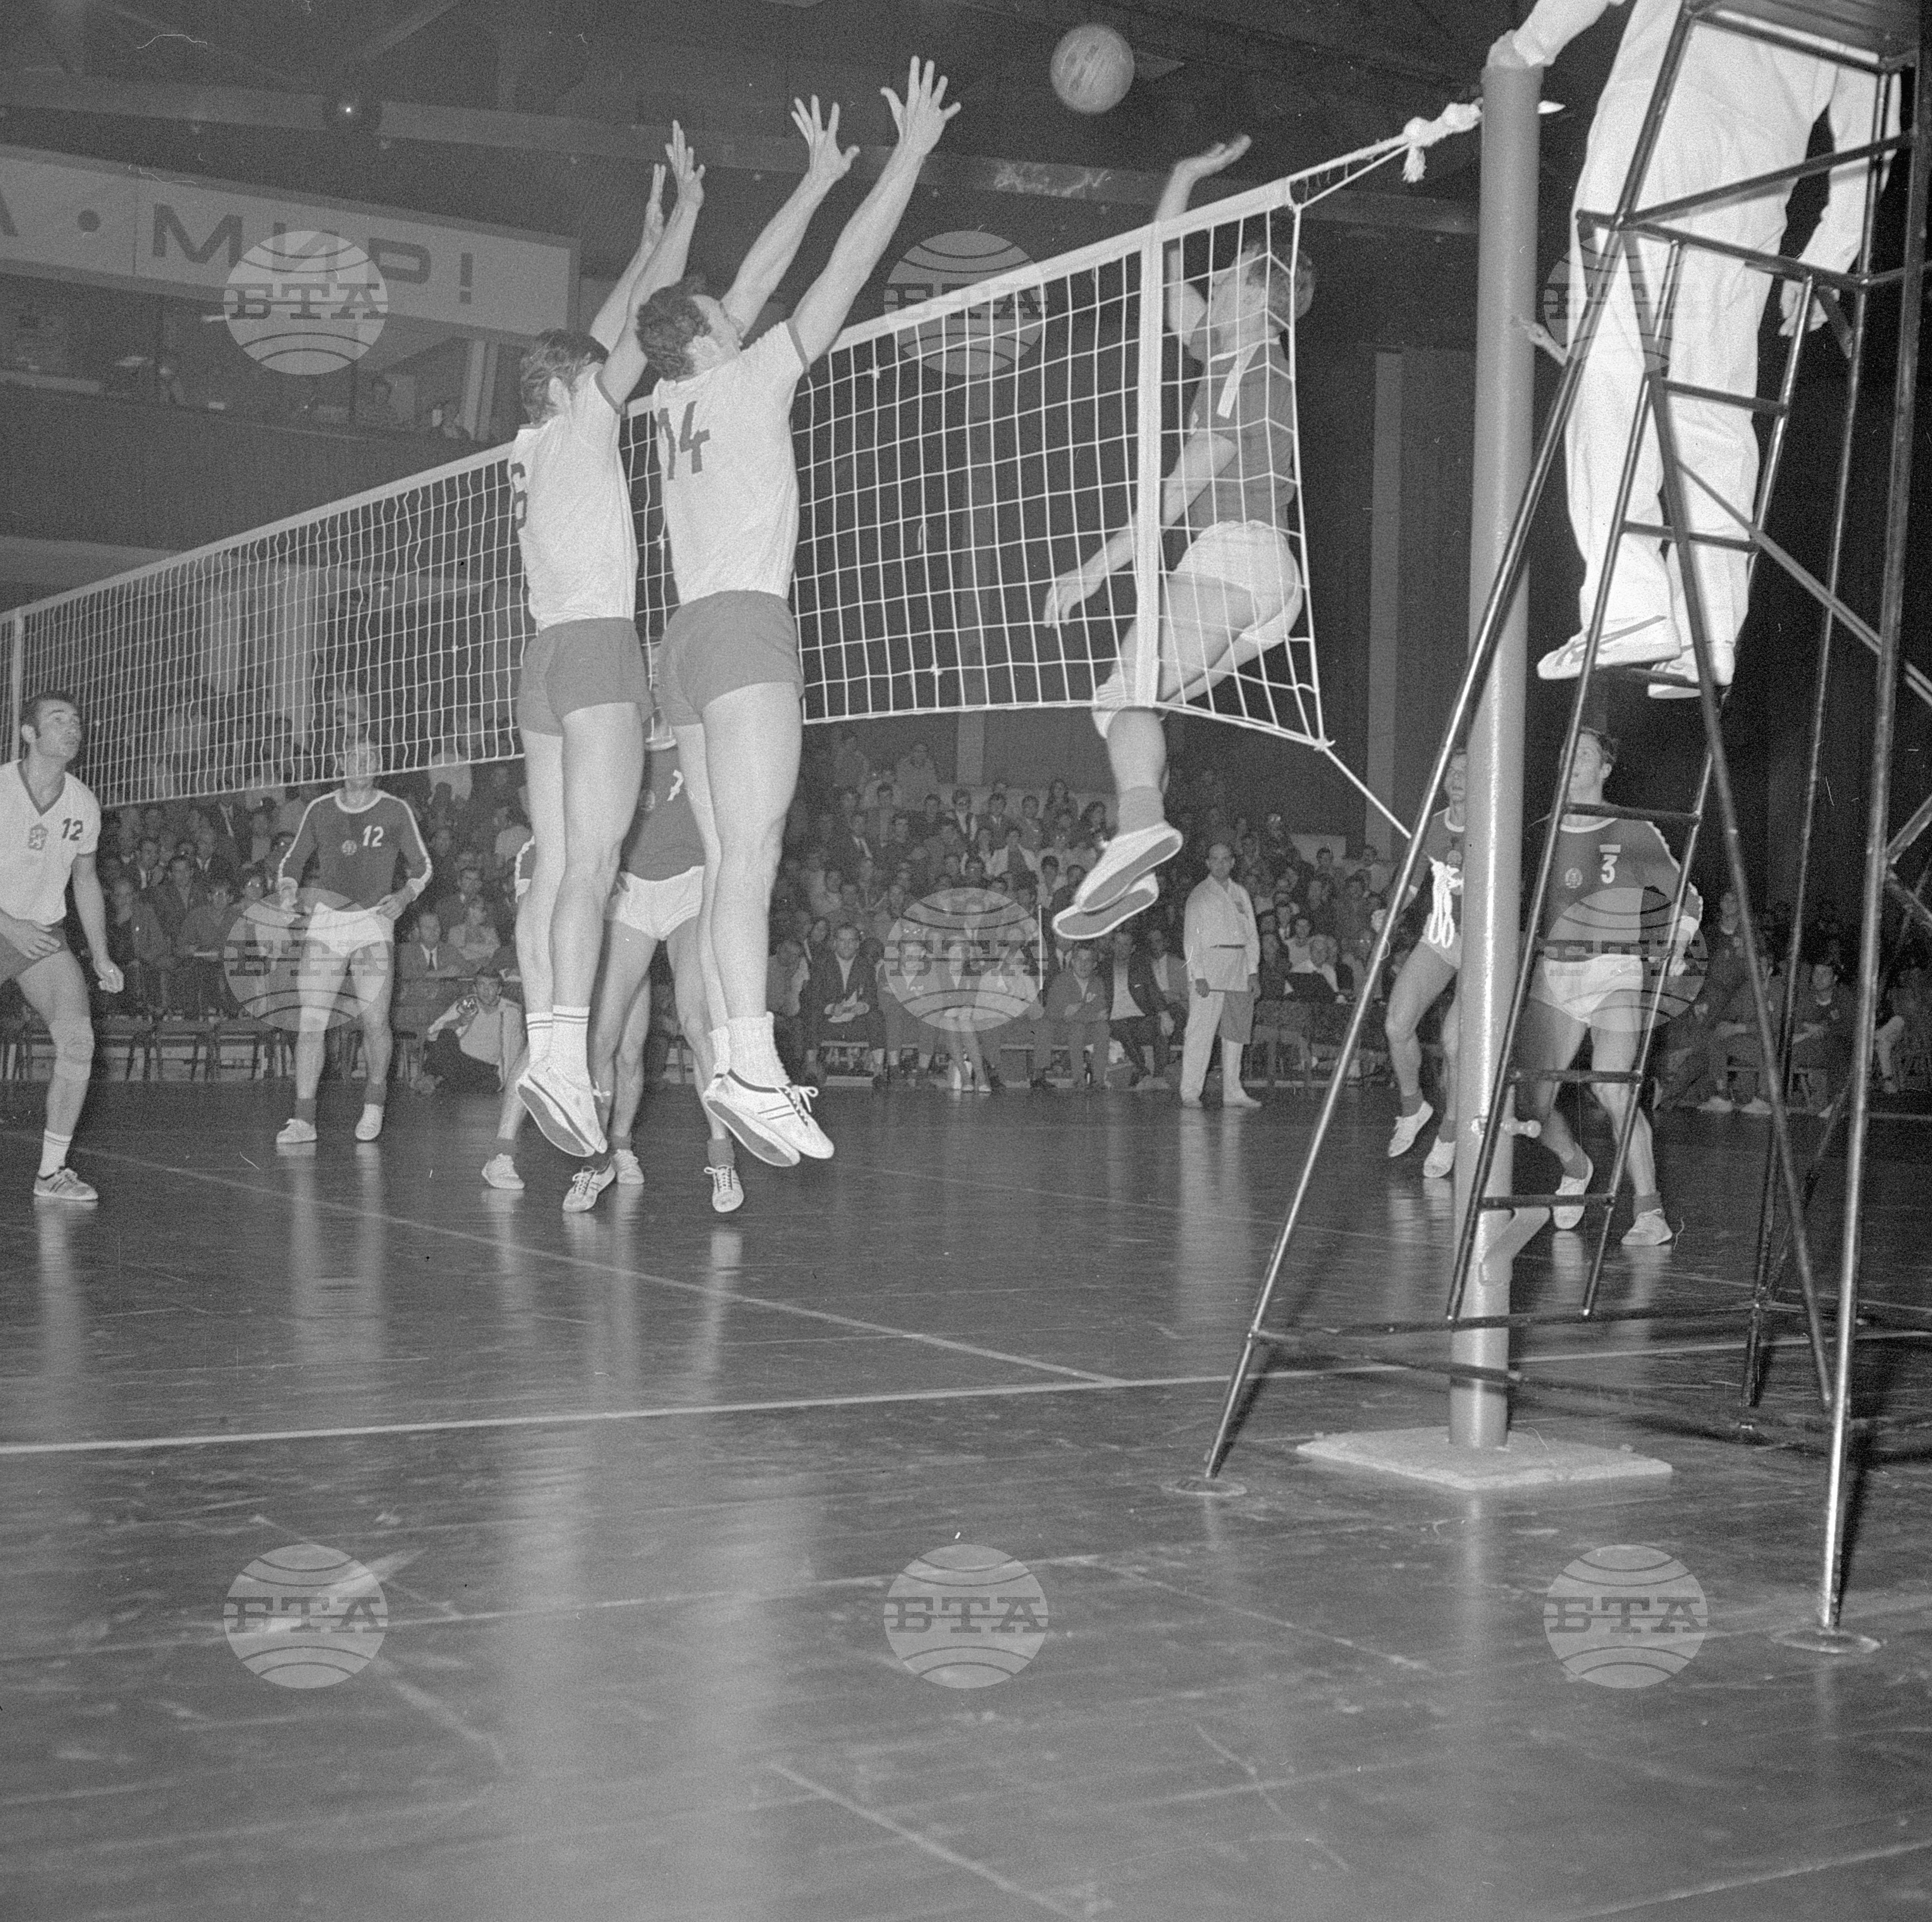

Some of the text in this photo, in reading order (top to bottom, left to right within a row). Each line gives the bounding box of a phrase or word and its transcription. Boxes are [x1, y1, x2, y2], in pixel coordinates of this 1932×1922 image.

[152, 203, 473, 305] МИР!
[657, 400, 710, 480] 14
[62, 818, 83, 841] 12
[363, 825, 384, 847] 12
[1601, 854, 1618, 884] 3
